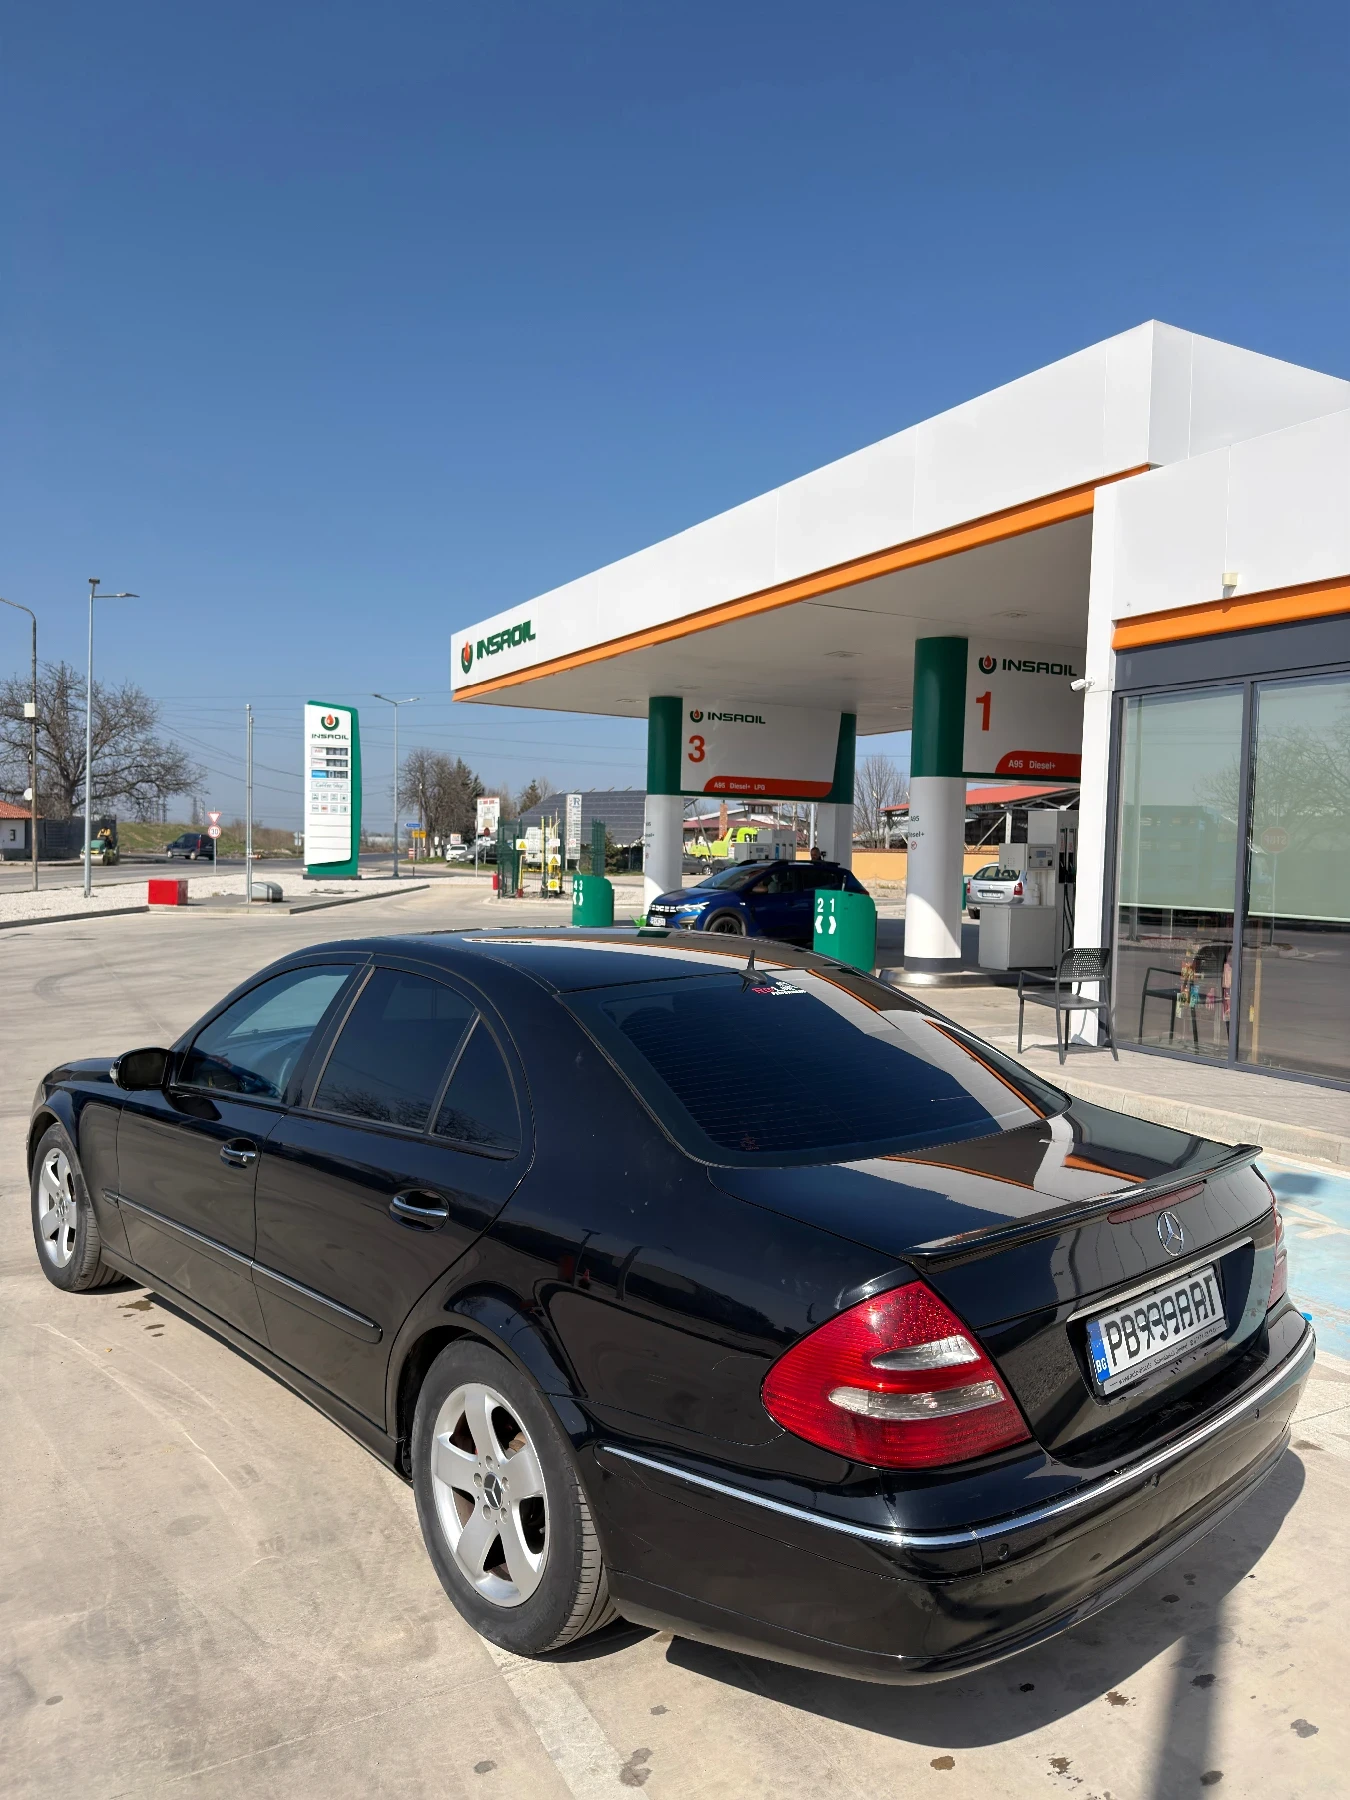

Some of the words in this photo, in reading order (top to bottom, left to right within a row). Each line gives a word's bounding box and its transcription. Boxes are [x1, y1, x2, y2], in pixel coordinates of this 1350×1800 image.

[477, 620, 536, 660] INSAOIL
[1002, 658, 1077, 677] INSAOIL
[707, 711, 766, 725] INSAOIL
[975, 691, 992, 731] 1
[687, 734, 706, 763] 3
[1008, 759, 1024, 768] A95
[1029, 760, 1056, 770] Diesel+
[817, 897, 824, 913] 2
[829, 897, 835, 913] 1
[1095, 1359, 1108, 1373] BG
